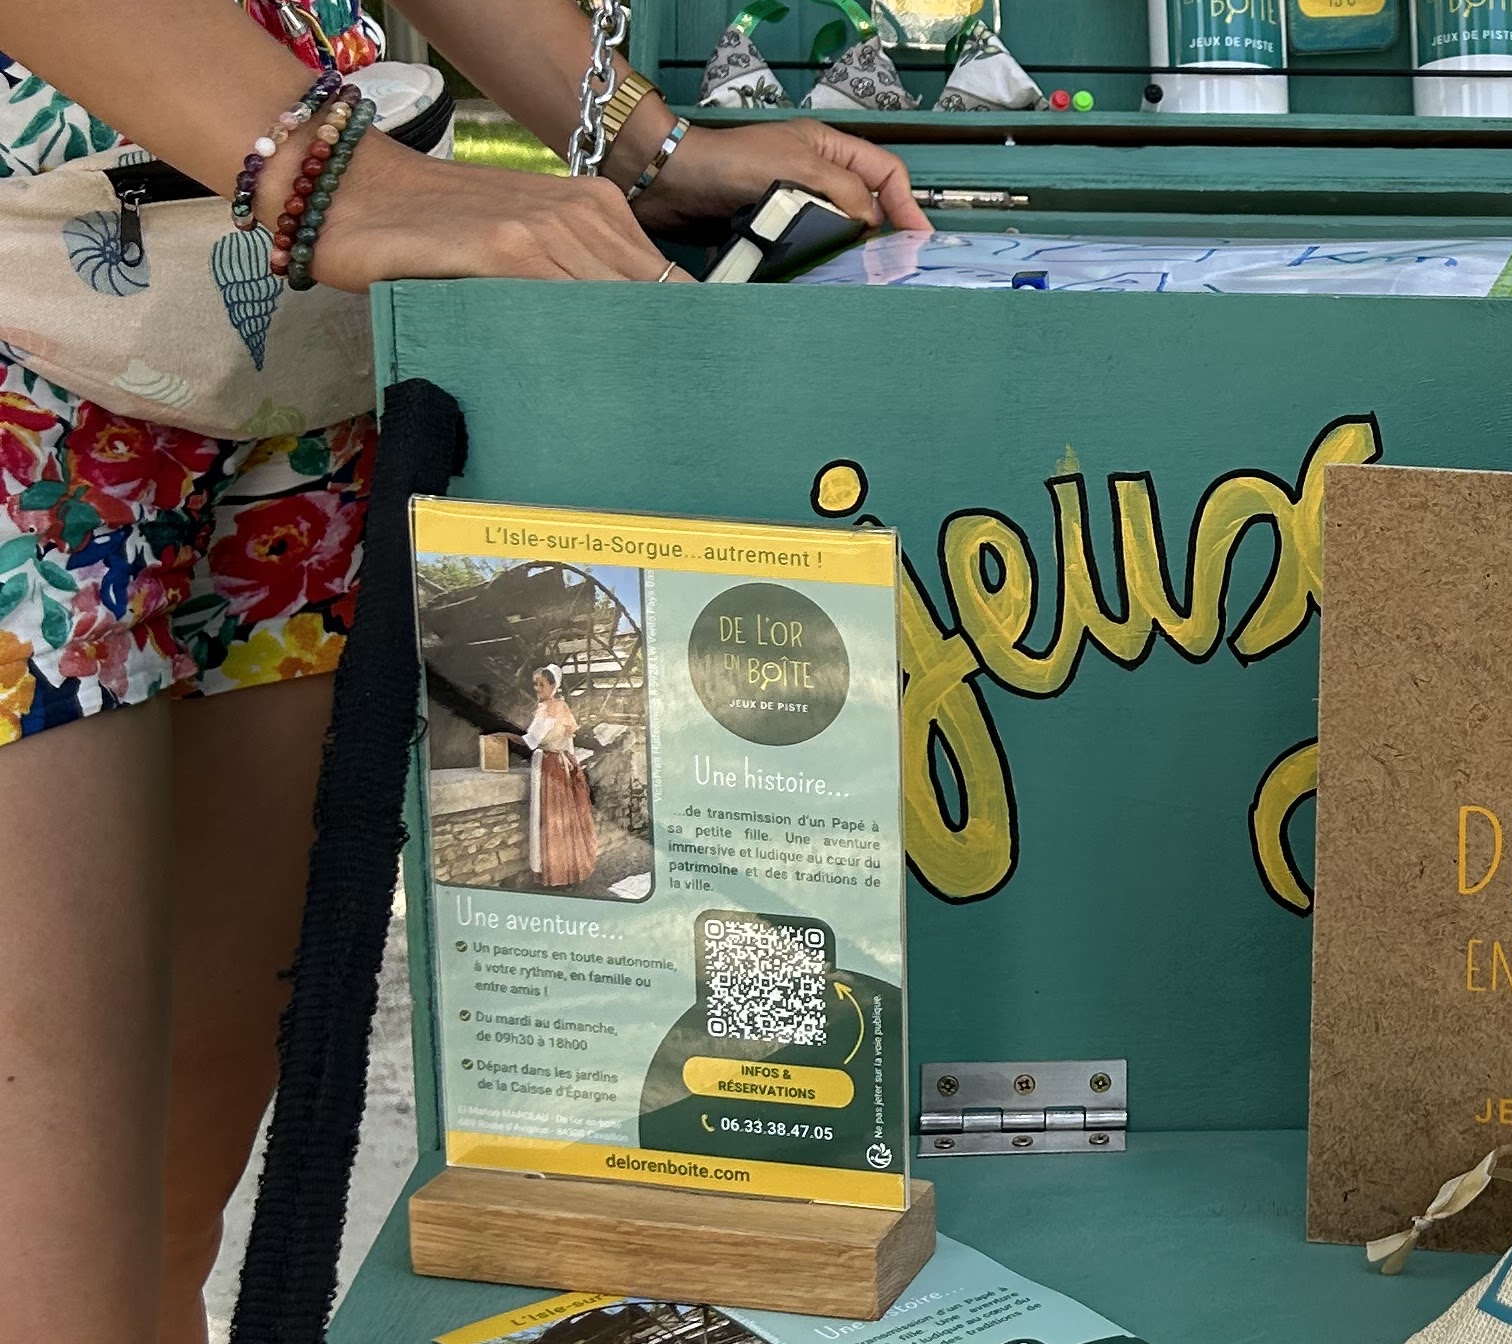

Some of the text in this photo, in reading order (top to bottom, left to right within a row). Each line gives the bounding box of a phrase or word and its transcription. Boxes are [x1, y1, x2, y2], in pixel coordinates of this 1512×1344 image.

[1189, 35, 1275, 53] JEUX DE PISTE
[1431, 32, 1459, 47] JEUX
[1462, 30, 1478, 41] DE
[719, 613, 804, 648] DE L'OR
[747, 655, 814, 690] BOÎTE
[729, 698, 809, 713] JEUX DE PISTE
[694, 754, 850, 798] Une histoire...
[707, 808, 865, 833] transmission d'un Papé
[667, 824, 880, 851] sa petite Une aventure
[668, 840, 735, 857] immersive
[739, 847, 752, 858] et
[755, 844, 803, 863] ludique
[807, 856, 823, 865] au
[864, 857, 881, 869] du
[669, 861, 881, 888] patrimoine et des traditions de
[670, 877, 714, 891] la ville.
[455, 895, 623, 941] Une aventure...
[473, 941, 490, 953] Un
[493, 944, 549, 959] parcours
[552, 950, 567, 960] en
[570, 951, 603, 965] toute
[485, 964, 517, 976] votre
[570, 972, 586, 981] en
[588, 972, 632, 986] famille
[635, 977, 651, 988] ou
[475, 982, 541, 996] entre amis
[475, 1011, 492, 1023] Du
[496, 1013, 531, 1027] mardi
[535, 1018, 550, 1029] au
[476, 1030, 588, 1051] de 09h30 18h00
[477, 1060, 618, 1084] Départ dans jardins
[741, 1065, 792, 1080] INFOS &
[478, 1078, 553, 1096] de Caisse
[718, 1080, 816, 1100] RÉSERVATIONS
[720, 1116, 833, 1141] 06.33.38.47.05
[605, 1154, 751, 1183] delorenboite.com
